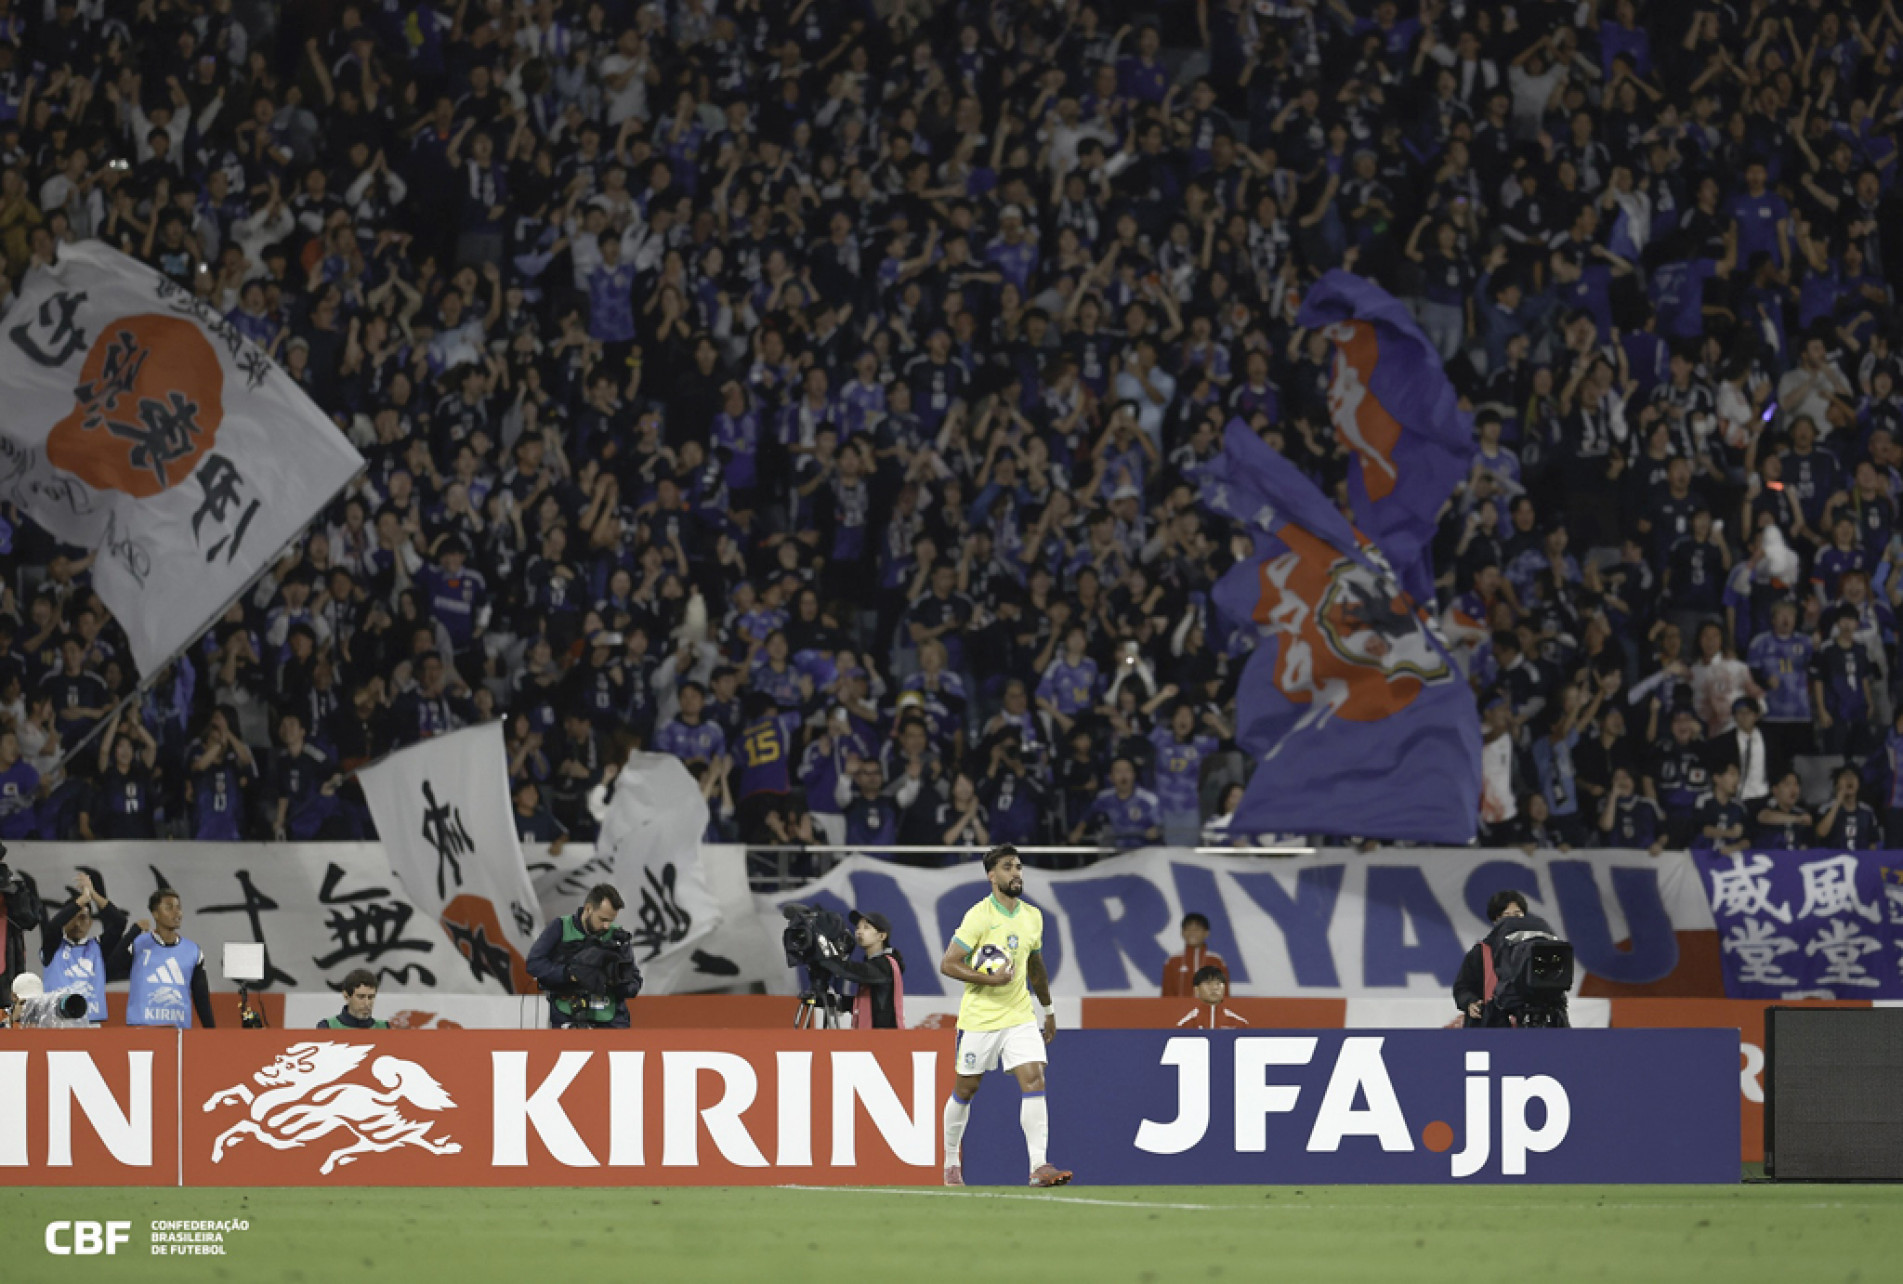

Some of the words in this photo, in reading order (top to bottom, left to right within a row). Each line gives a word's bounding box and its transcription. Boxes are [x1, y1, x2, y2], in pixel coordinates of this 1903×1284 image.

[745, 729, 781, 768] 15
[142, 948, 152, 967] 7
[144, 1006, 185, 1022] KIRIN
[491, 1051, 938, 1166] KIRIN
[1133, 1036, 1571, 1178] JFA.jp
